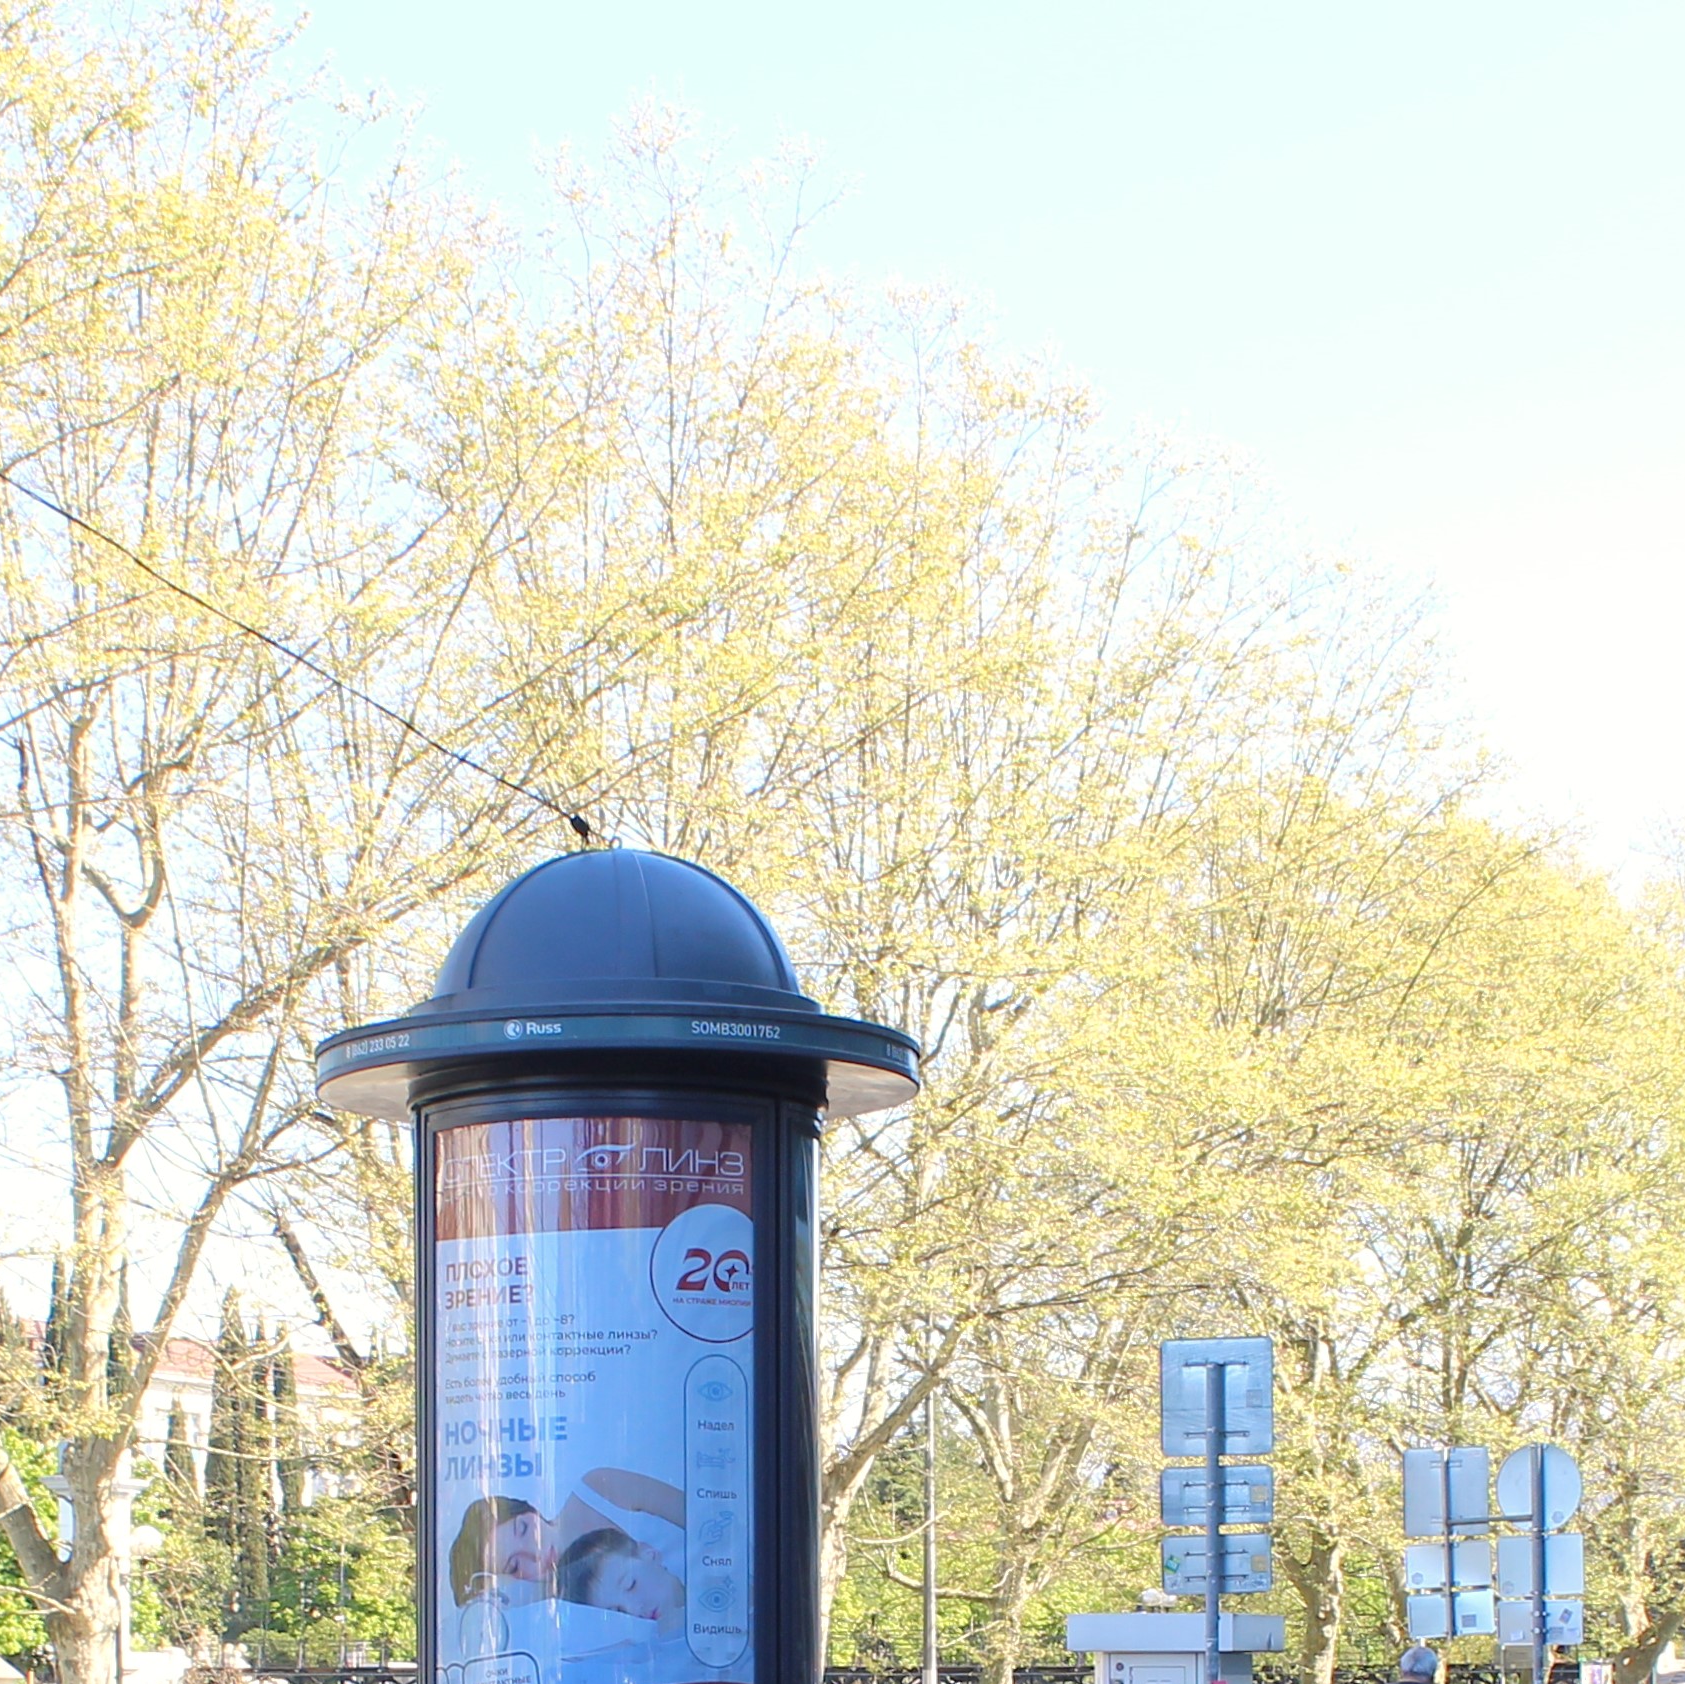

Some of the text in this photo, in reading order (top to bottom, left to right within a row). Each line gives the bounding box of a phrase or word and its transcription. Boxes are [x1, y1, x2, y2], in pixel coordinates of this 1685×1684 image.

[526, 1021, 562, 1035] Russ
[369, 1039, 384, 1053] 233
[385, 1037, 397, 1050] 05
[398, 1035, 410, 1048] 22
[443, 1148, 745, 1186] СПЕКТР ЛИНЗ
[504, 1177, 647, 1195] коррекции
[653, 1178, 745, 1195] зрения
[445, 1256, 529, 1283] ПЛОХОЕ
[675, 1247, 750, 1293] 20
[730, 1281, 750, 1291] ЛЕТ
[445, 1284, 534, 1311] ЗРЕНИЕ?
[686, 1297, 717, 1306] СТРАЖЕ
[507, 1317, 518, 1329] от
[535, 1316, 550, 1327] до
[529, 1330, 604, 1343] контактные
[607, 1328, 659, 1341] линзы?
[549, 1344, 631, 1358] коррекции?
[445, 1378, 463, 1391] Есть
[549, 1370, 596, 1385] способ
[505, 1389, 531, 1400] весь
[534, 1387, 567, 1400] день
[445, 1415, 568, 1447] НОЧНЫЕ
[697, 1419, 735, 1431] Надел
[445, 1452, 543, 1482] ЛИНЗЫ
[696, 1488, 738, 1500] Спишь
[701, 1556, 732, 1567] Снял
[692, 1623, 742, 1636] Видишь
